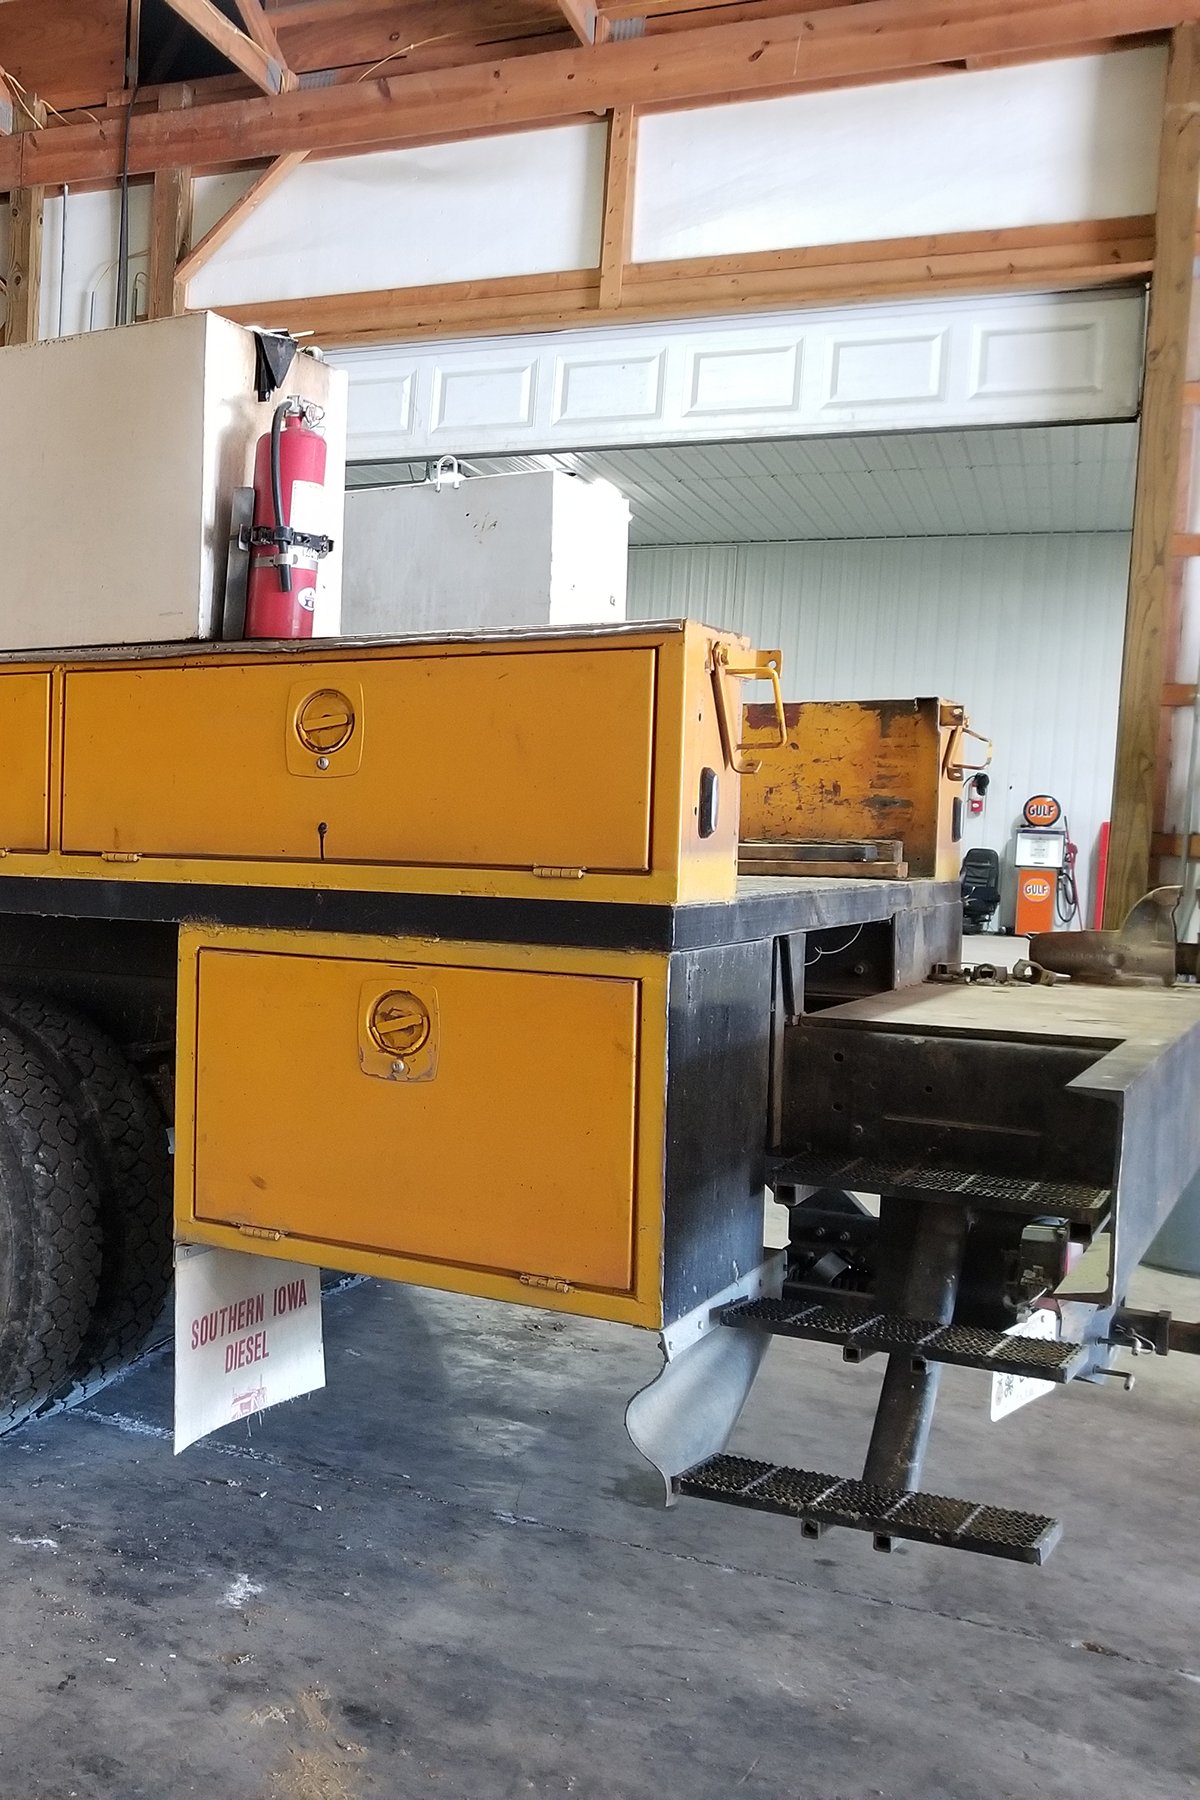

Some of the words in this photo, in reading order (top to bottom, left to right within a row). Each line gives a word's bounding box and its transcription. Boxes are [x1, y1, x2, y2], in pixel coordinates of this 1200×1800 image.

[1028, 804, 1055, 817] GULF
[1025, 884, 1049, 896] GULF
[191, 1293, 265, 1350] SOUTHERN
[273, 1279, 308, 1317] IOWA
[224, 1331, 270, 1374] DIESEL
